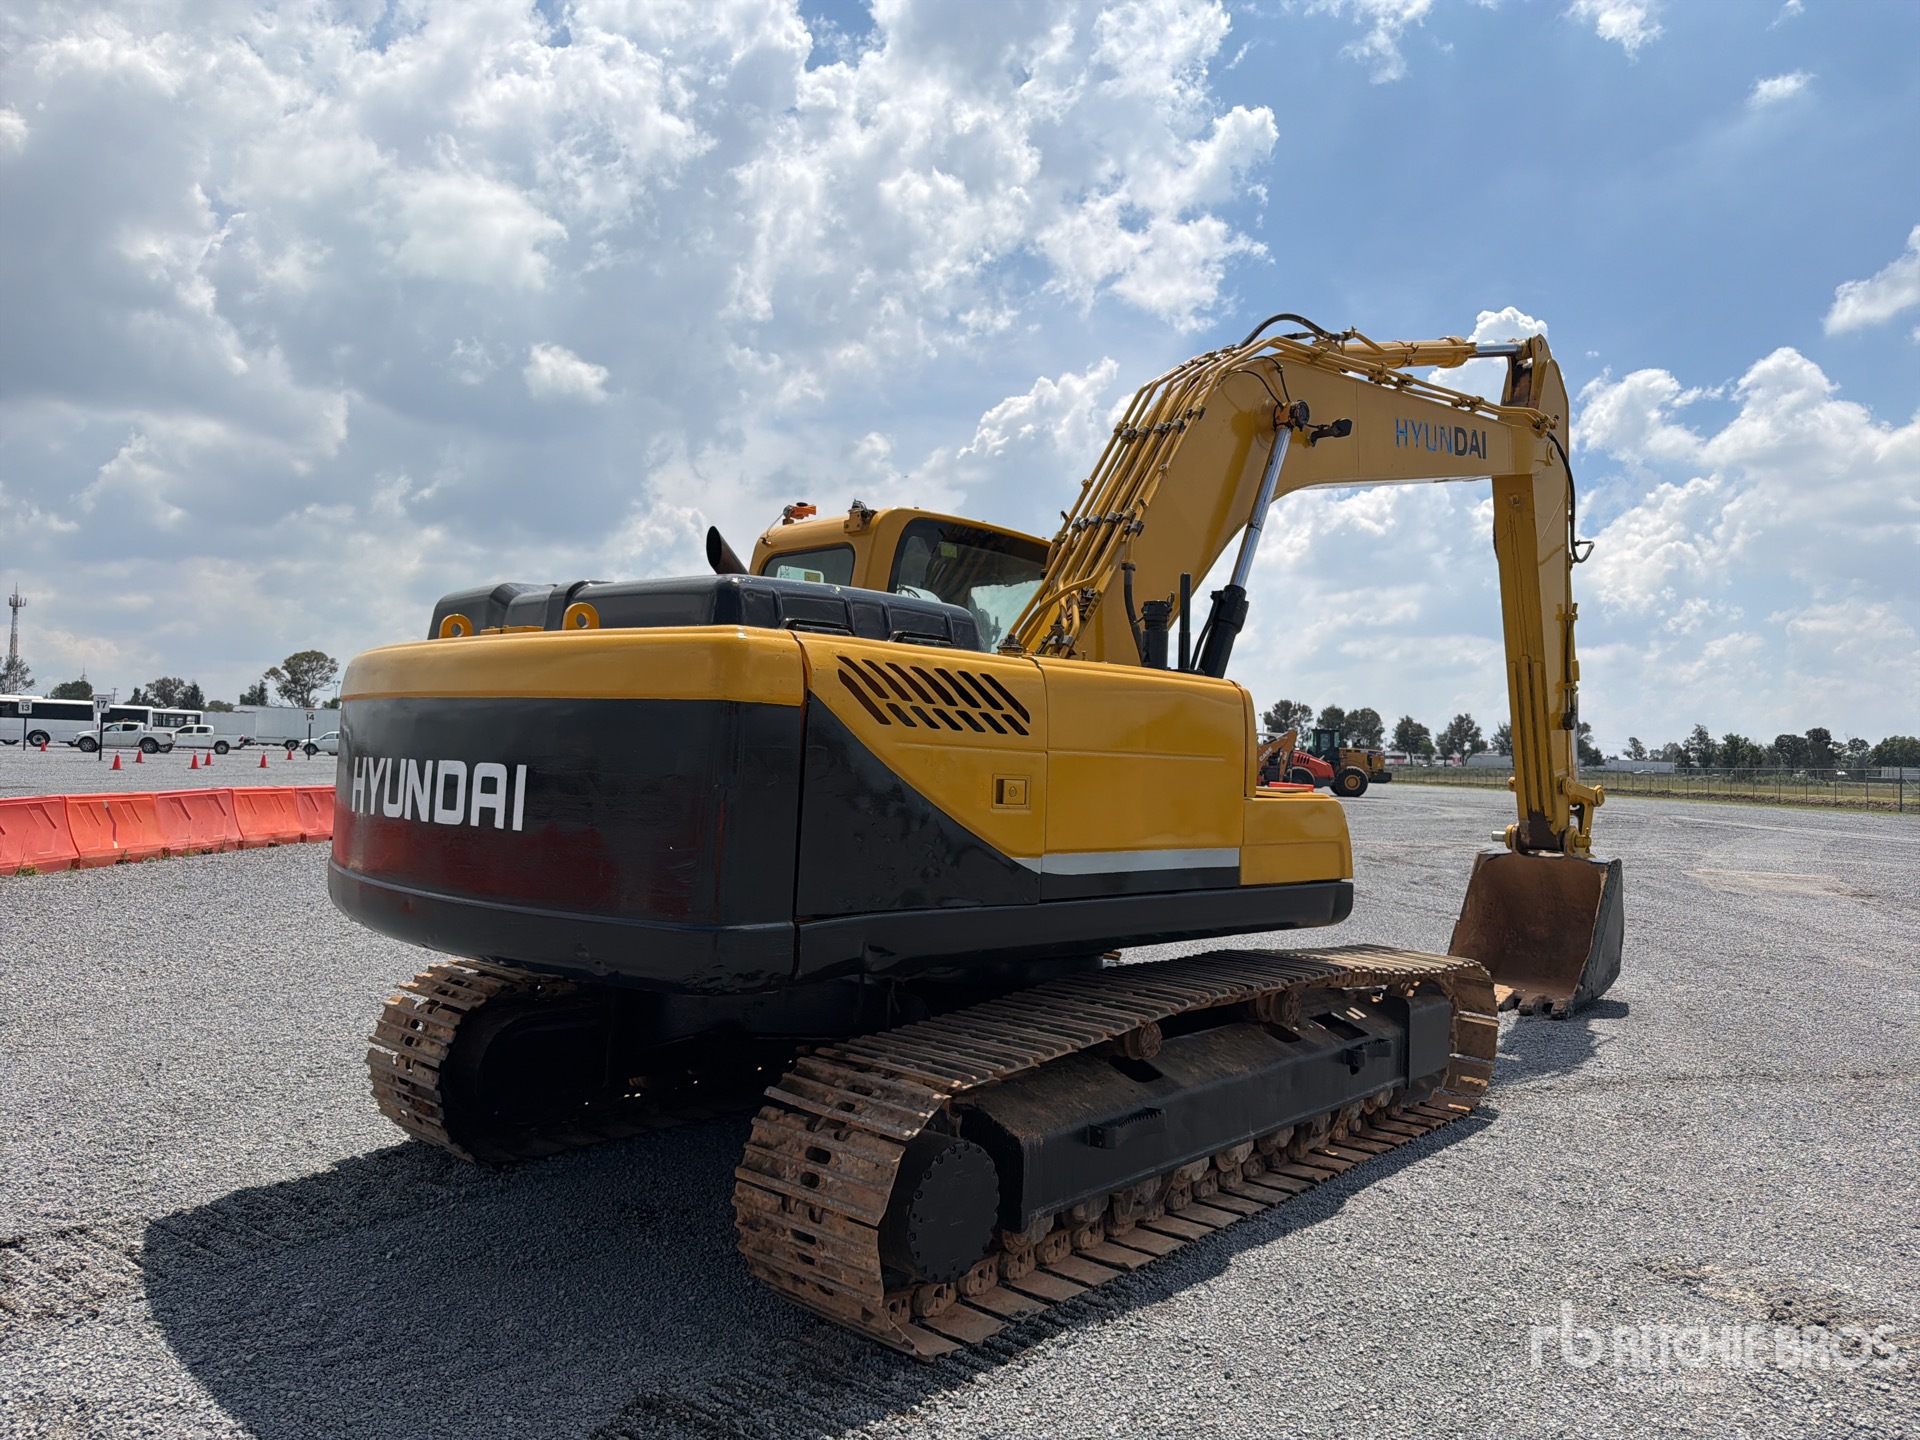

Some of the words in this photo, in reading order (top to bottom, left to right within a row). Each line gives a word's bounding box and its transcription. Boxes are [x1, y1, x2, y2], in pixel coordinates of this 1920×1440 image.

[1395, 417, 1487, 460] HYUNDAI
[96, 700, 107, 709] 17
[306, 713, 314, 721] 14
[1259, 747, 1272, 761] CASE
[352, 756, 527, 831] HYUNDAI
